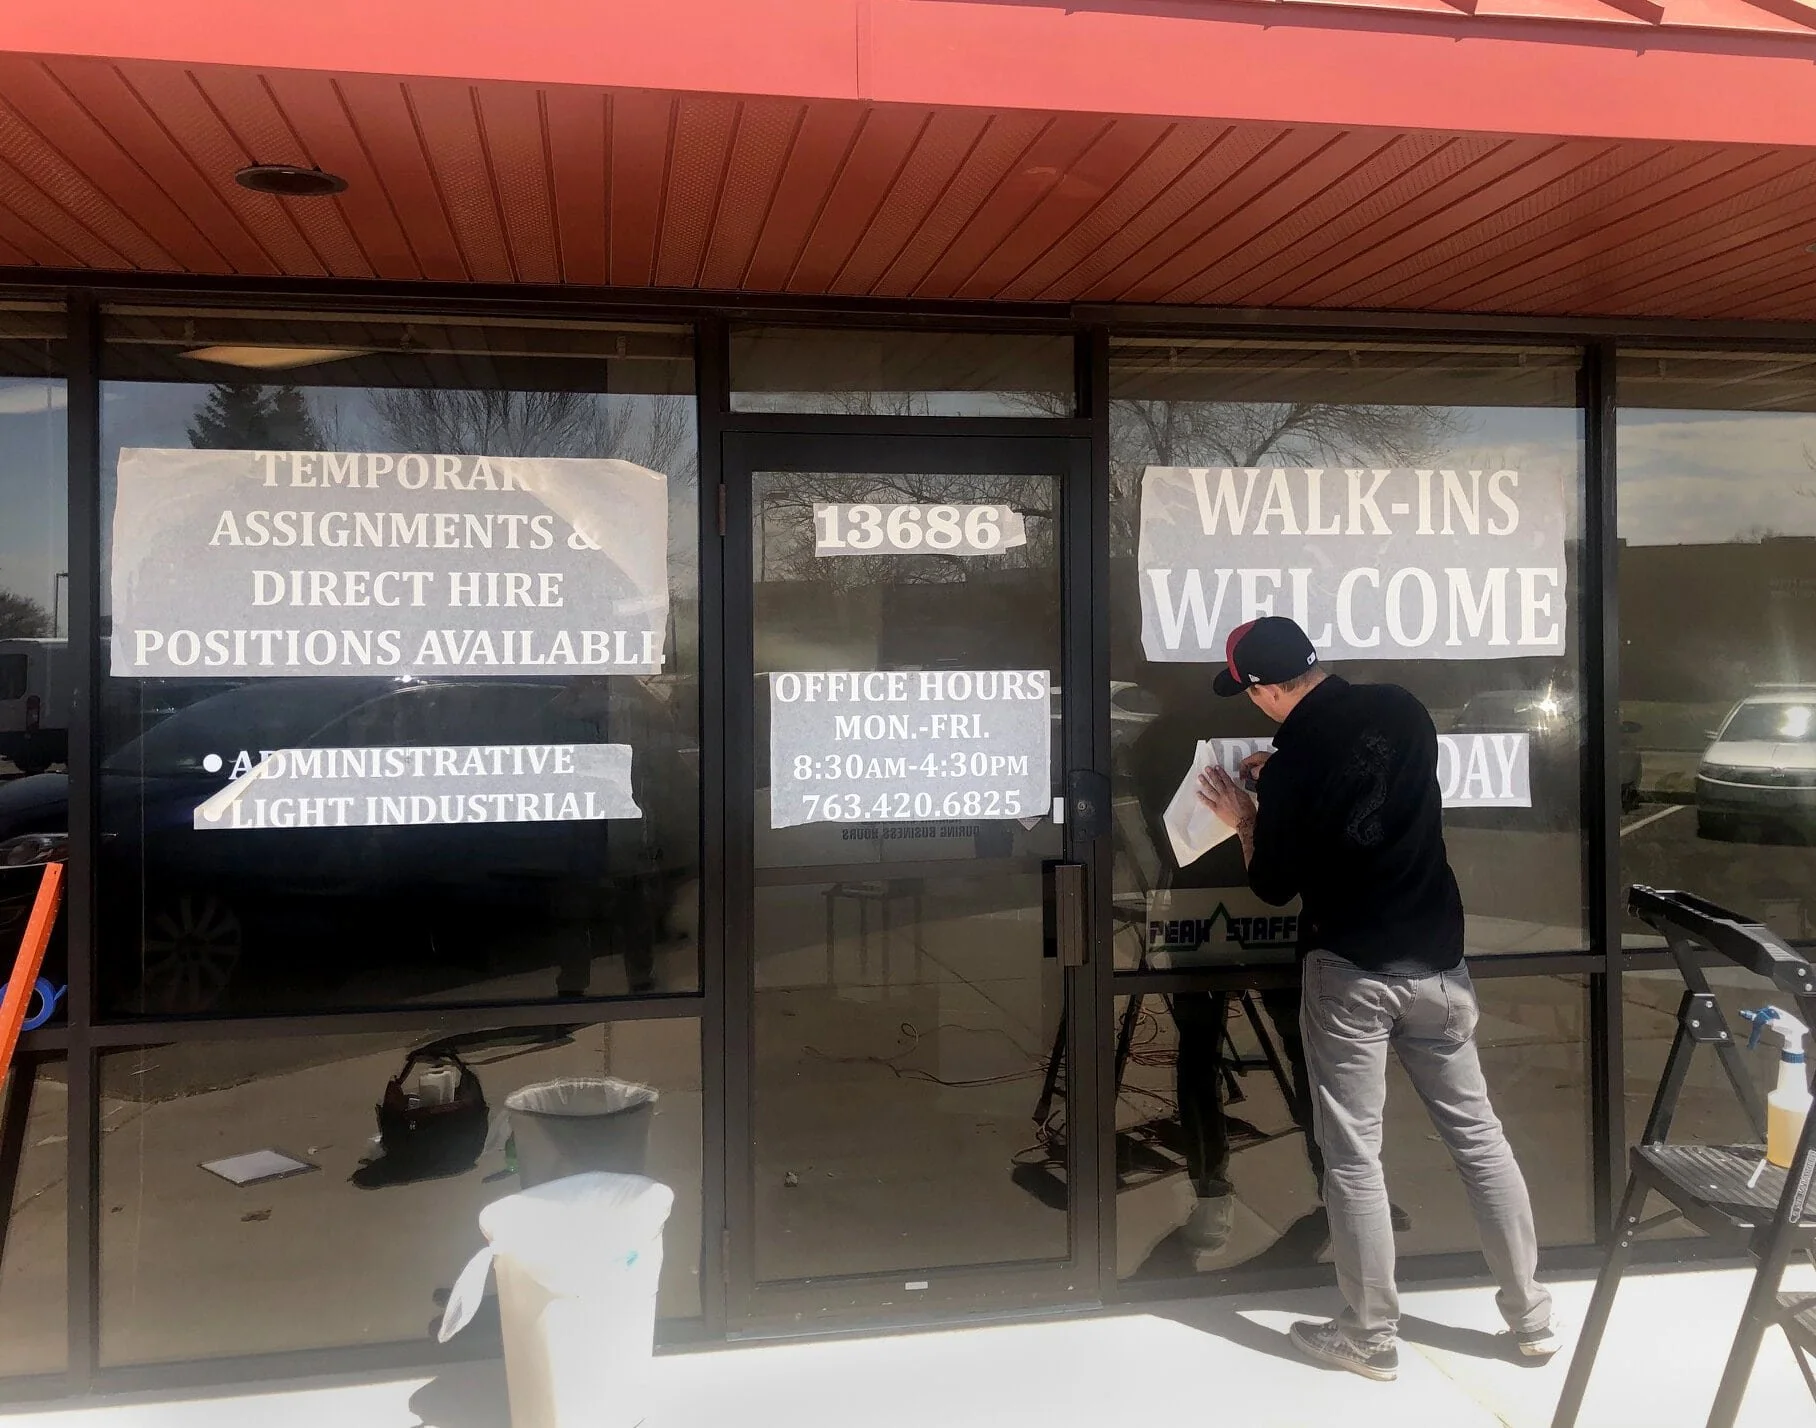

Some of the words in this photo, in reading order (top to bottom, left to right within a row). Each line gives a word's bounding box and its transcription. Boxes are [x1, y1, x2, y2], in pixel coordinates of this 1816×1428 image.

[254, 452, 532, 491] TEMPORAR
[1189, 468, 1519, 536] WALK-INS
[209, 510, 554, 550] ASSIGNMENTS
[567, 521, 601, 551] &
[817, 505, 1001, 550] 13686
[252, 570, 434, 607] DIRECT
[448, 572, 563, 607] HIRE
[1147, 567, 1558, 649] WELCOME
[134, 629, 402, 666] POSITIONS
[413, 629, 666, 665] AVAILABLE
[775, 671, 908, 702] OFFICE
[918, 671, 1046, 701] HOURS
[834, 713, 990, 740] MON.-FRI.
[228, 745, 574, 780] ADMINISTRATIVE
[793, 752, 1029, 780] 8:30AM-4:30PM
[231, 797, 354, 829] LIGHT
[365, 791, 605, 824] INDUSTRIAL
[801, 789, 1023, 820] 763.420.6825
